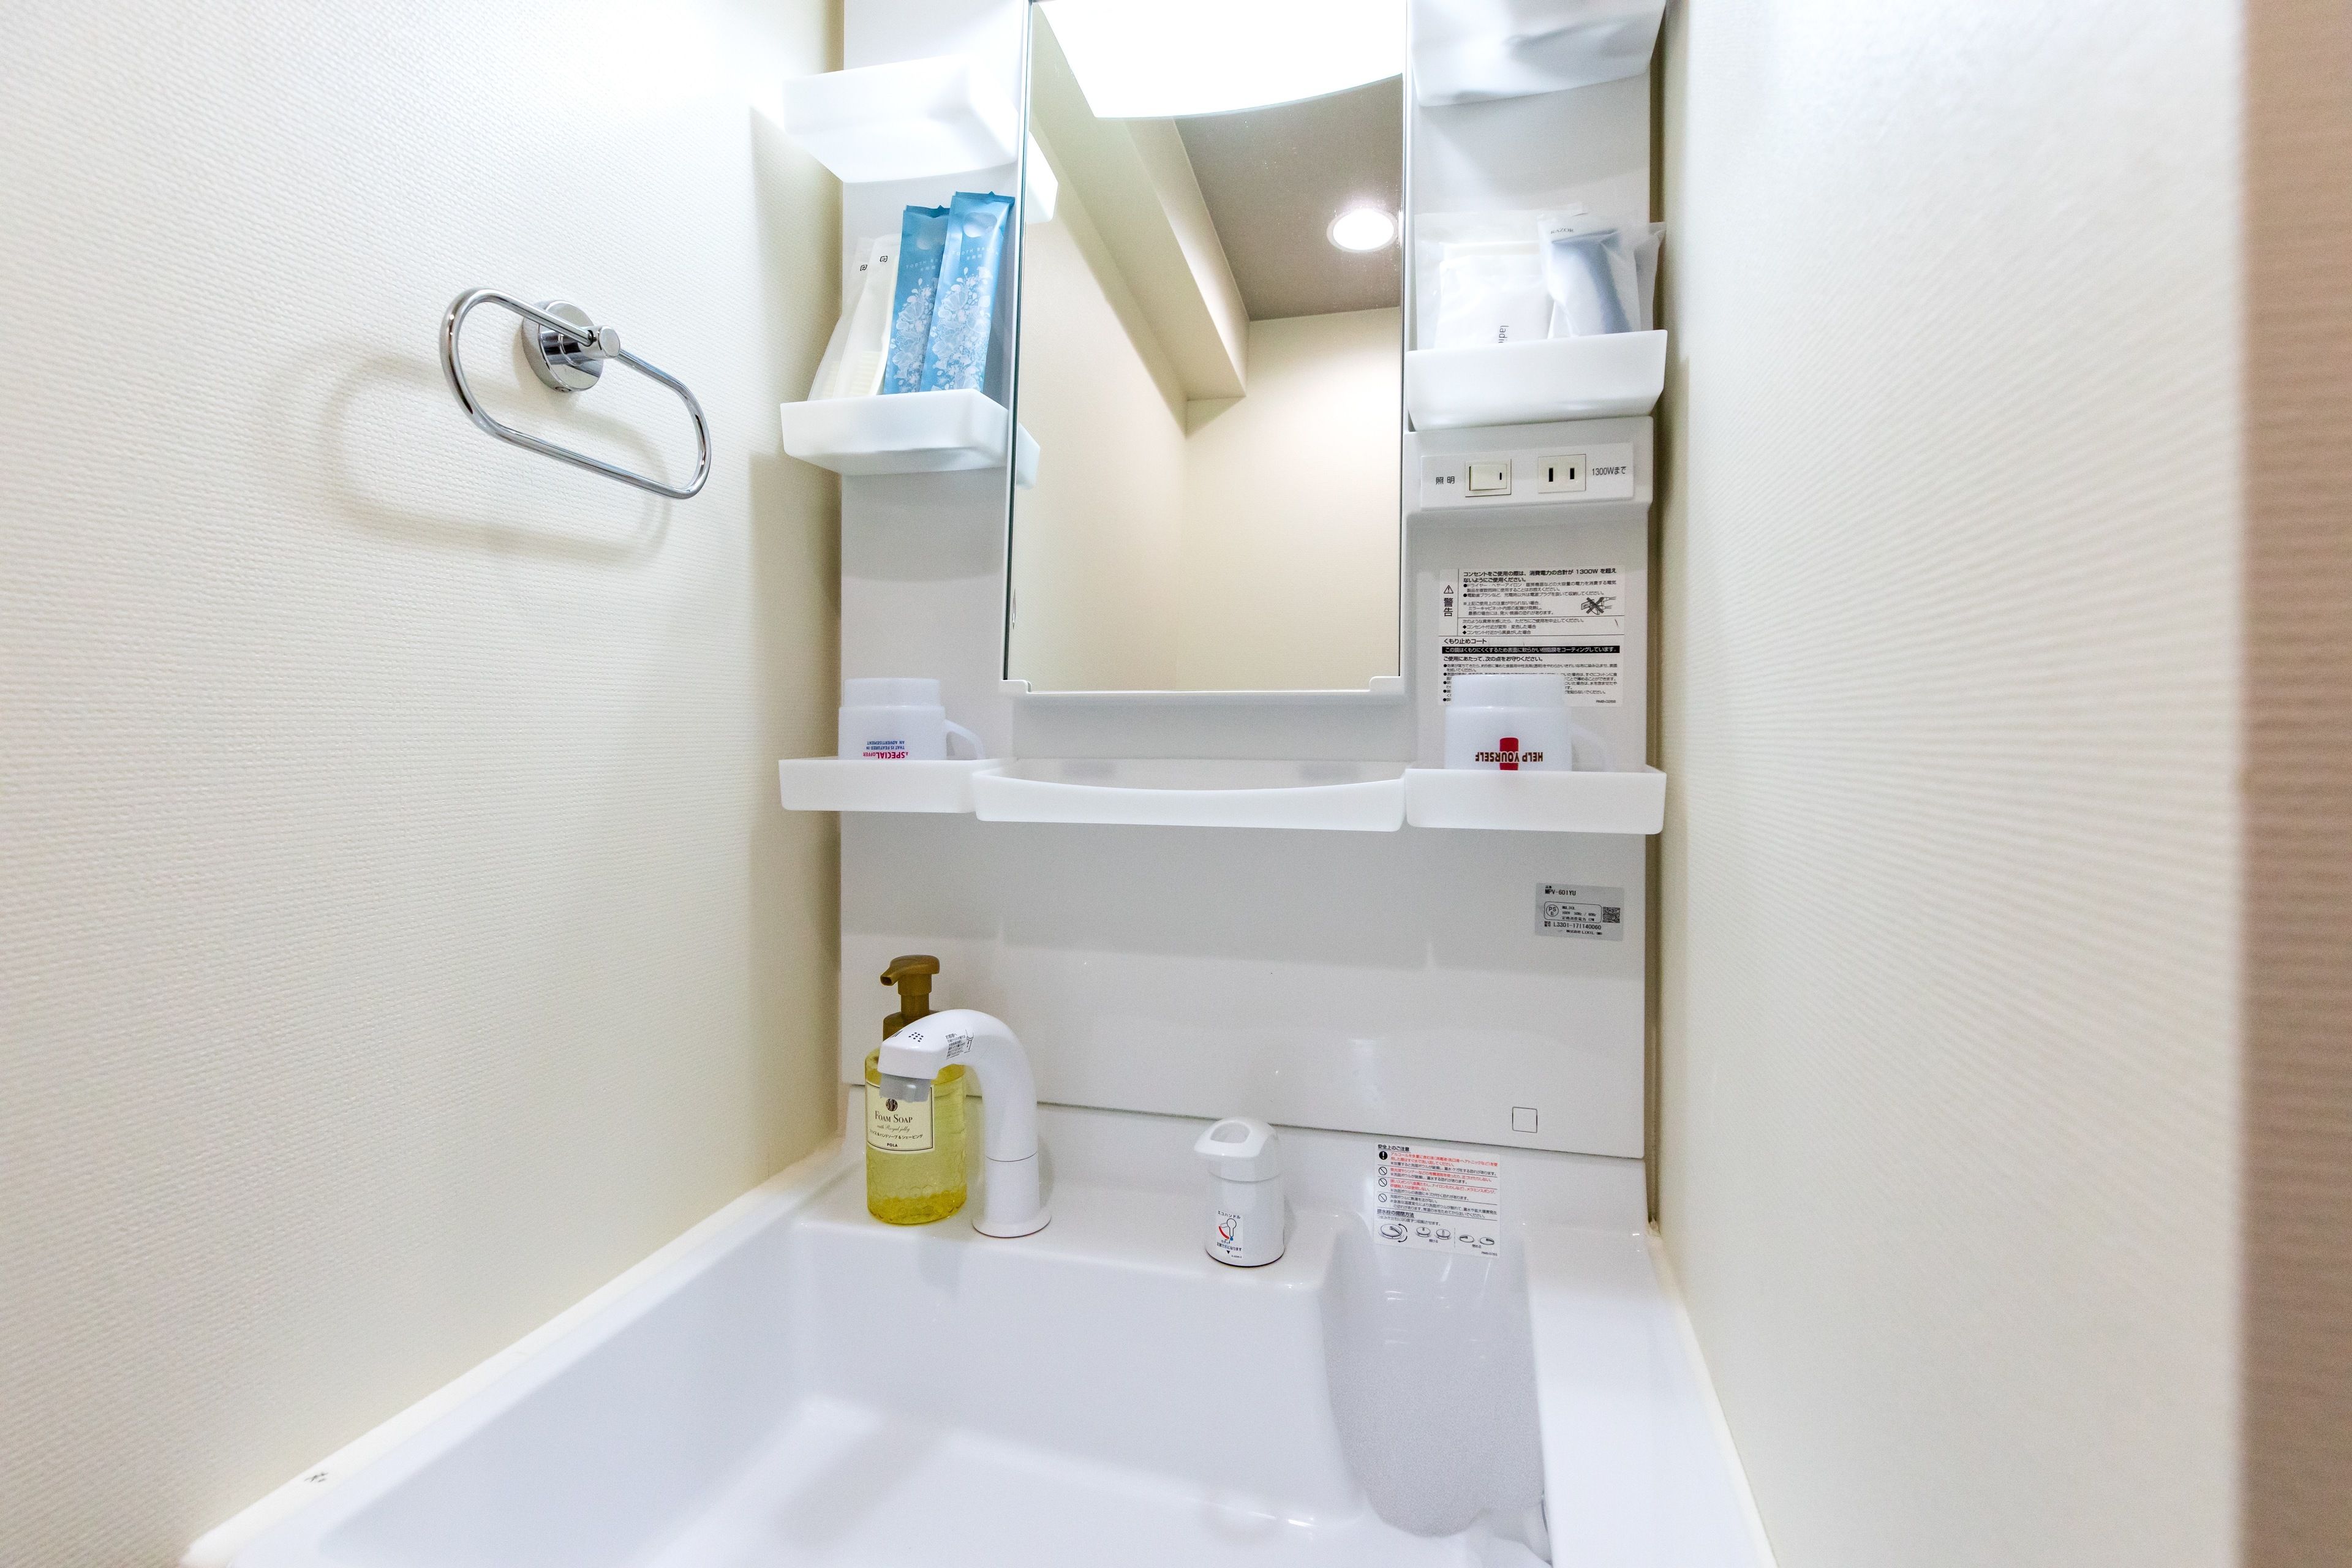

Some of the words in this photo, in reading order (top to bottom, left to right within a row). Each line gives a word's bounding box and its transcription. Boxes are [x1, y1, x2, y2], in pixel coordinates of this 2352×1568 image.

[1592, 466, 1627, 475] 1300Wまで
[1444, 598, 1453, 617] 警告
[1475, 752, 1520, 763] YOURSELF
[1522, 752, 1543, 762] HELP
[1218, 1210, 1241, 1219] エコハンドル
[1377, 1208, 1414, 1218] 排水栓の開閉方法
